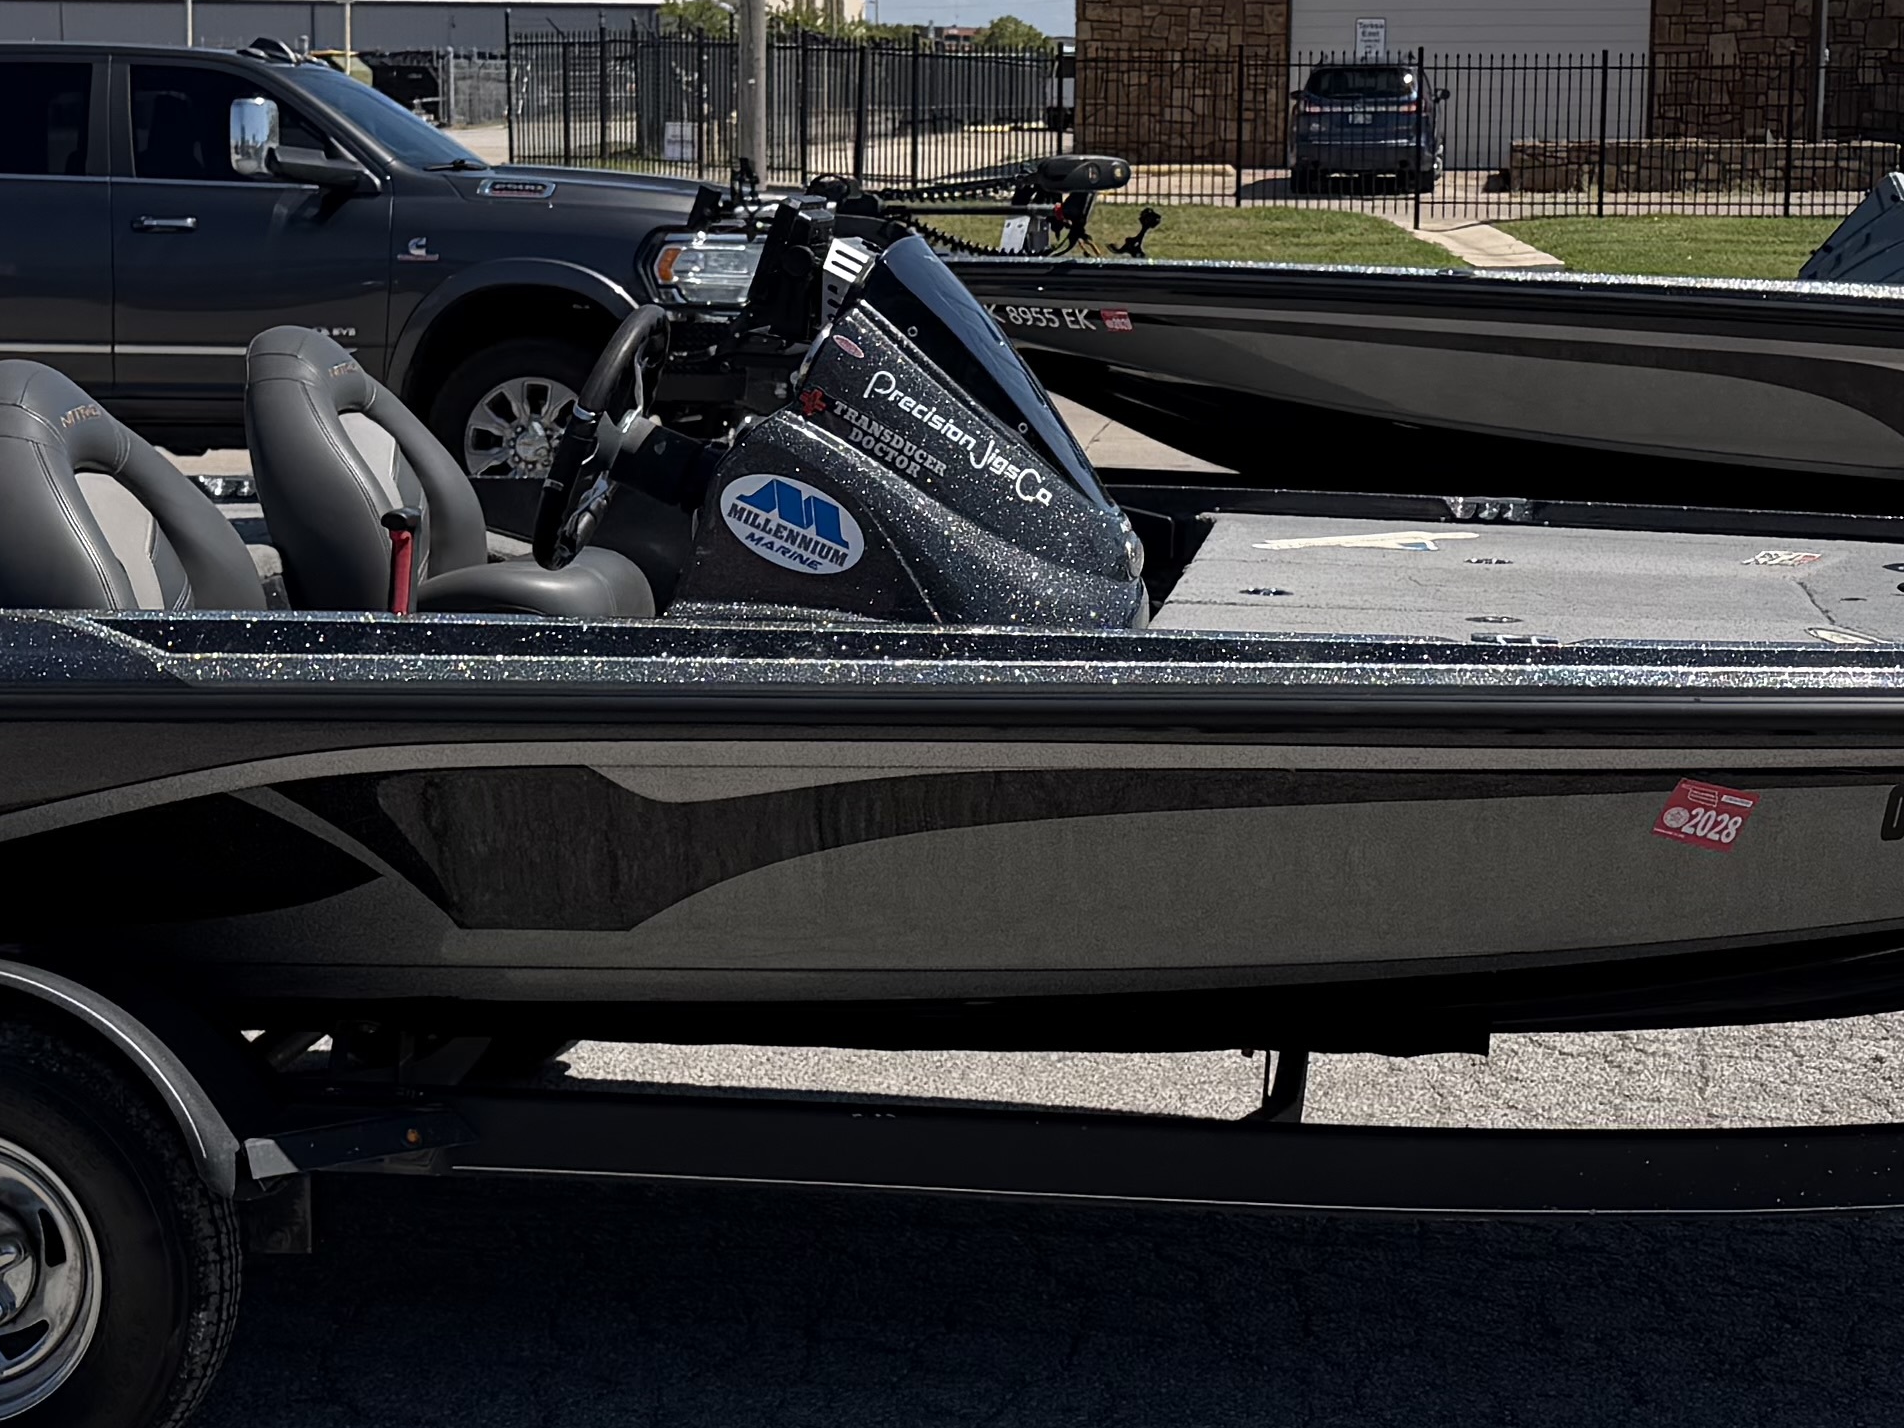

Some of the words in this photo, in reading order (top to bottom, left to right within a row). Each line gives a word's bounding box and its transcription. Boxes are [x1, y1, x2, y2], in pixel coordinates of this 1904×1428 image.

[1005, 305, 1060, 328] 8955
[1061, 308, 1097, 330] EK
[834, 400, 947, 477] TRANSDUCER
[848, 426, 922, 479] DOCTOR
[727, 502, 849, 568] MILLENNIUM
[745, 531, 824, 571] MARINE
[1681, 807, 1743, 844] 2028
